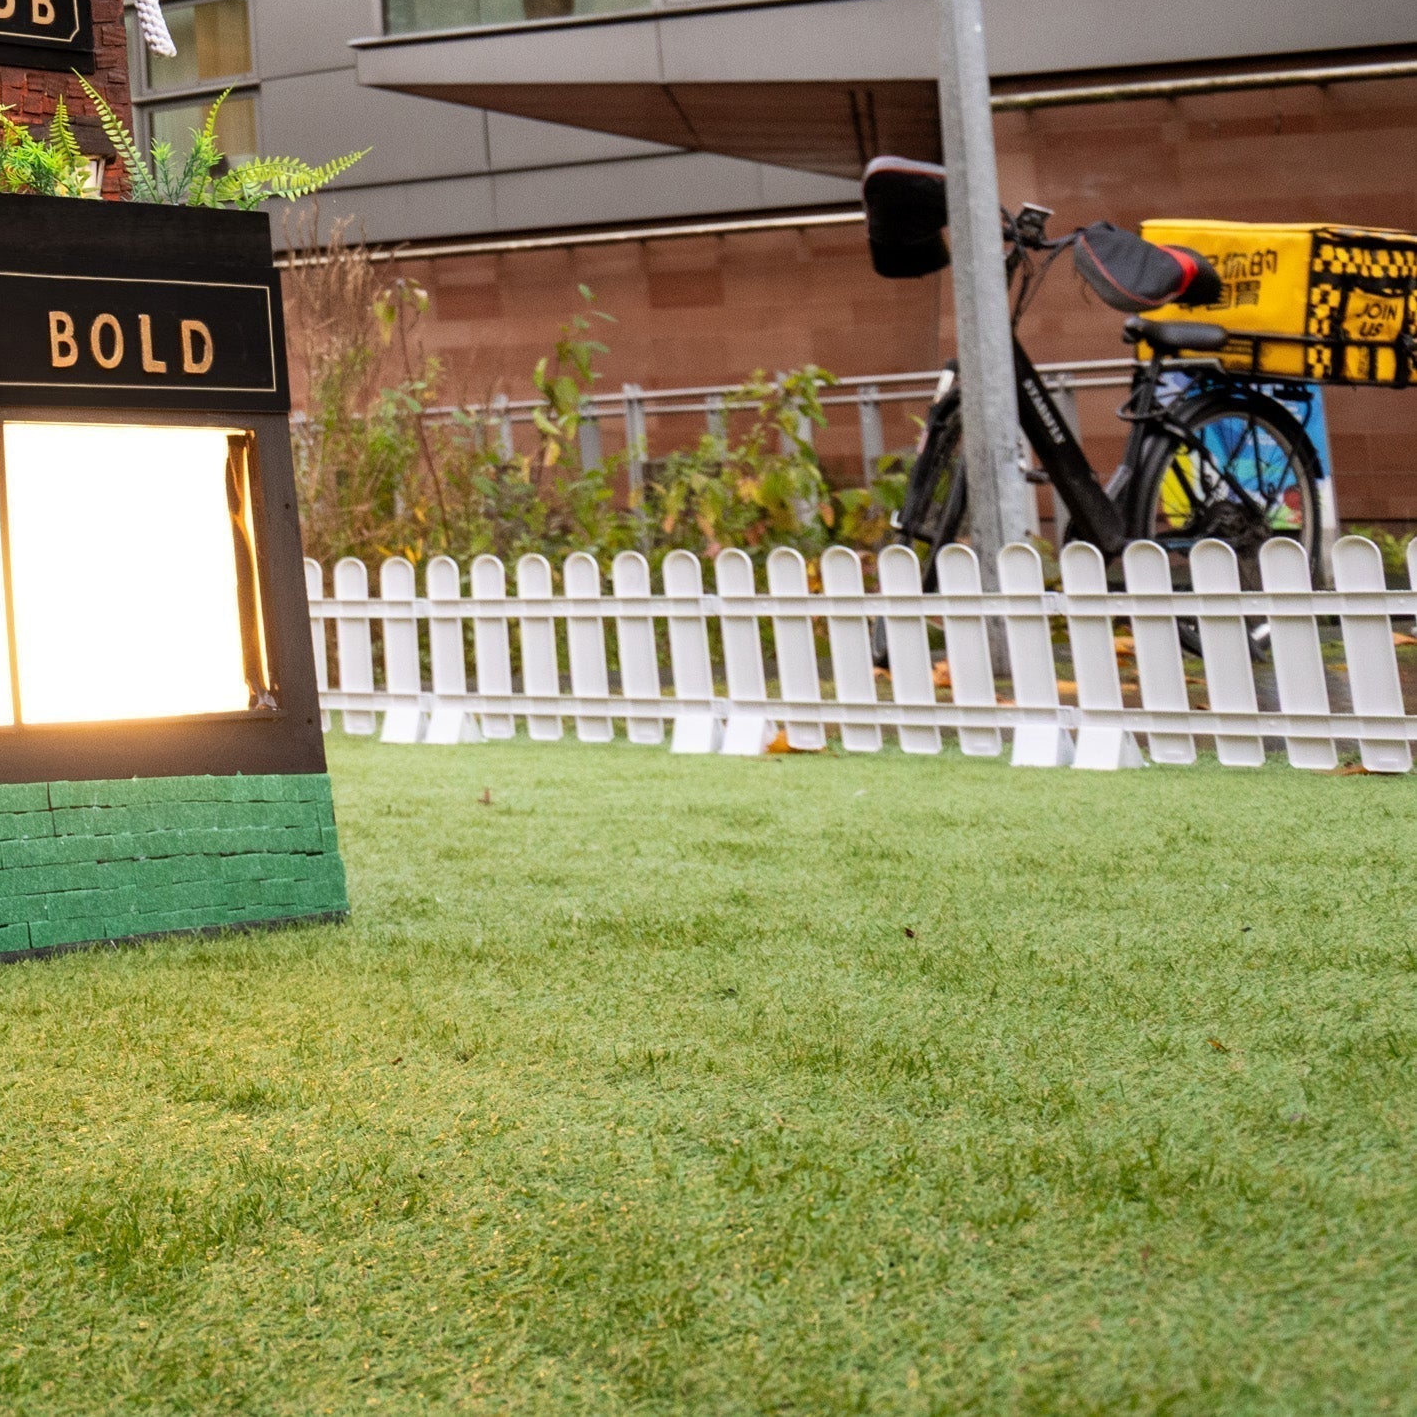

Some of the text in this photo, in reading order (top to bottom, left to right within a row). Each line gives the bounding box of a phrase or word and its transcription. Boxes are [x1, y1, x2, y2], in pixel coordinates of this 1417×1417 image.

[1355, 302, 1398, 321] JOIN
[1359, 321, 1384, 337] US
[48, 310, 214, 375] BOLD
